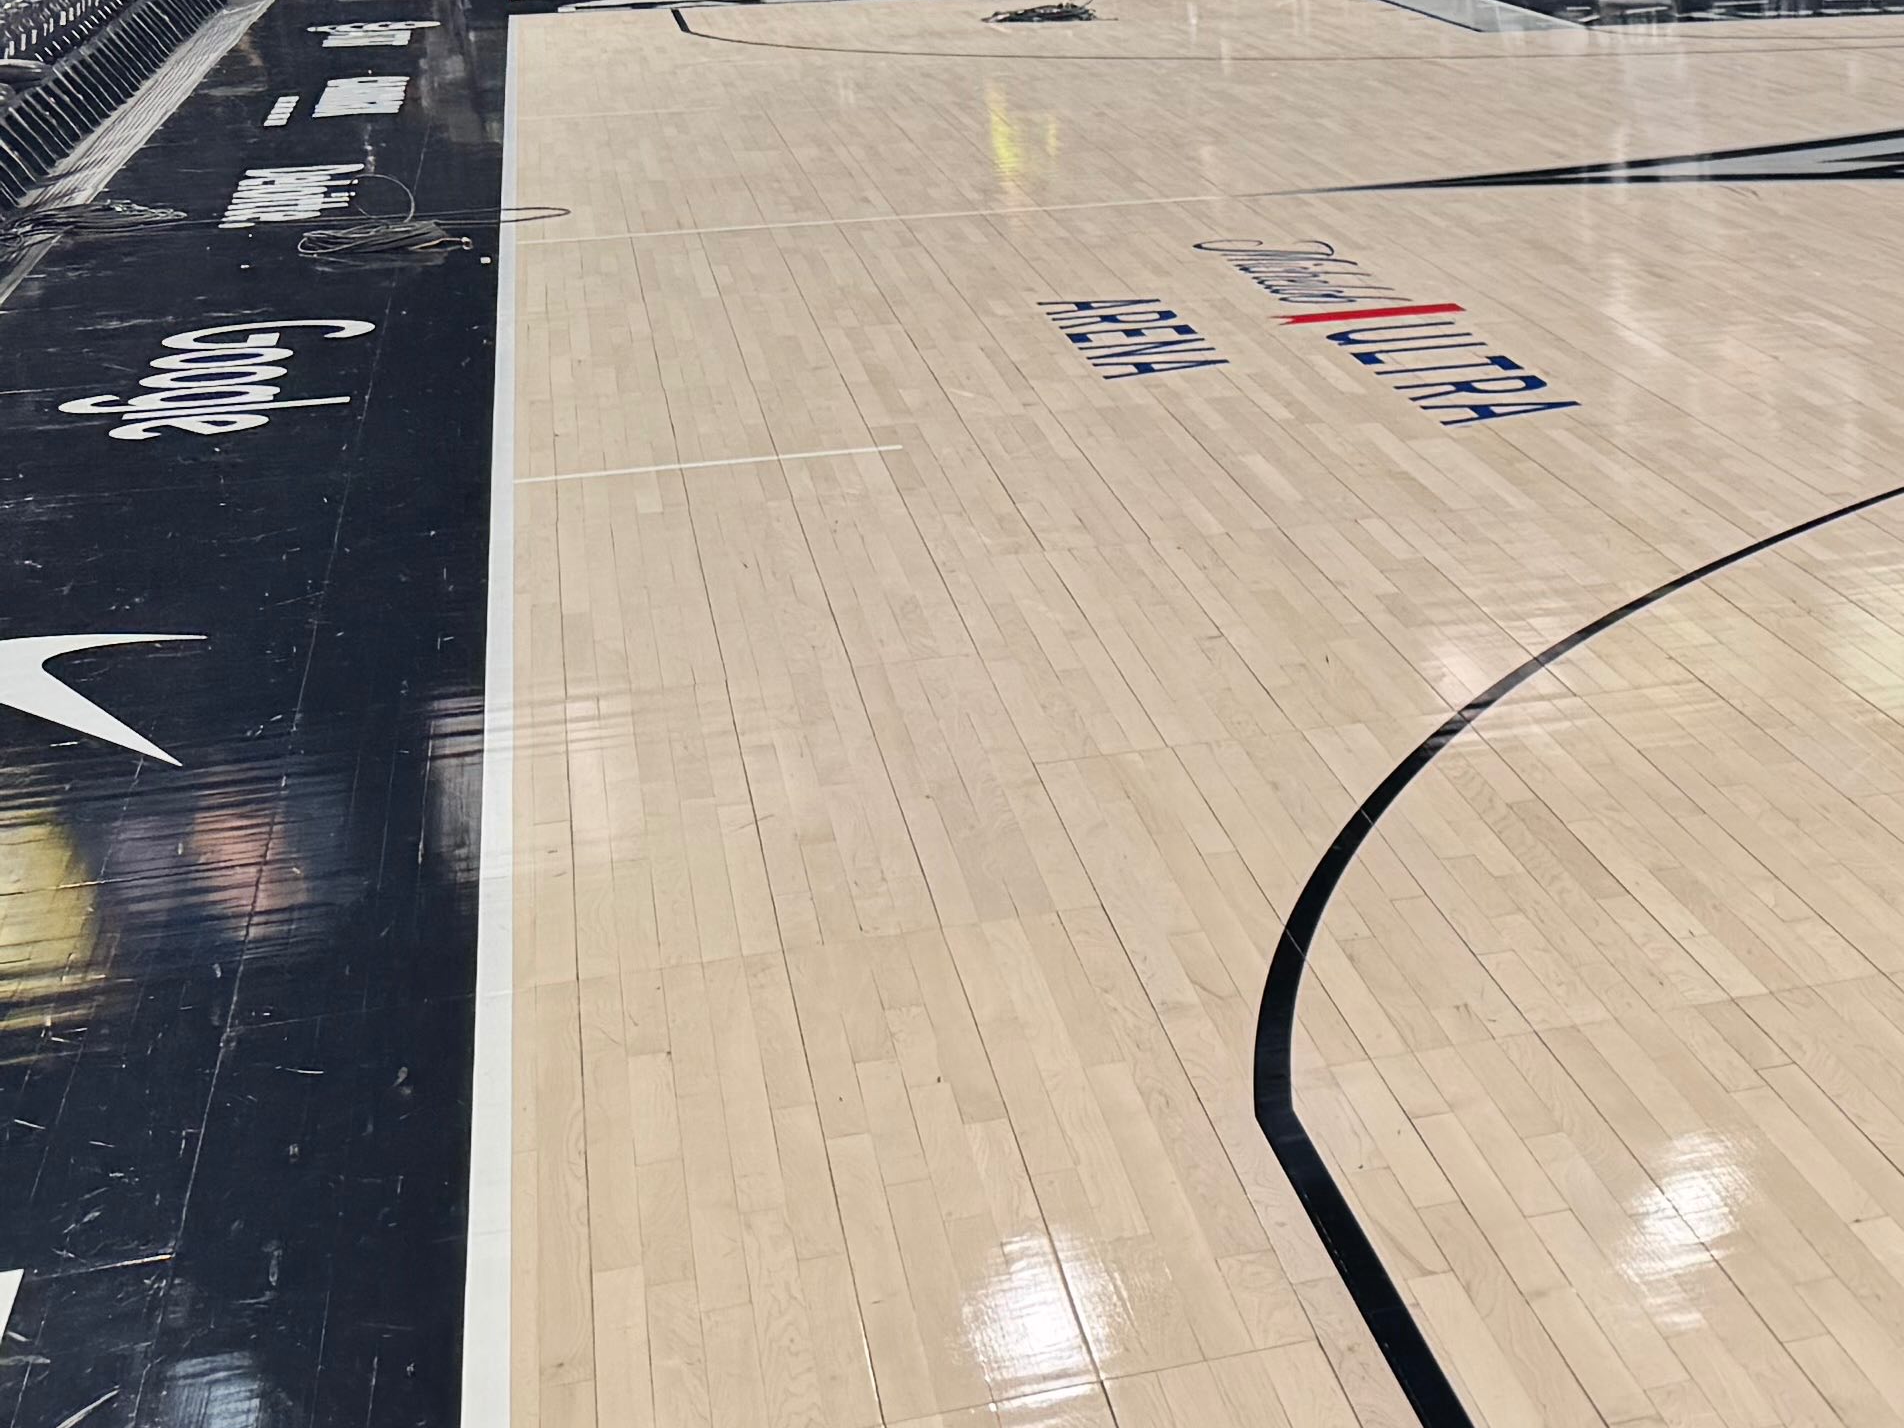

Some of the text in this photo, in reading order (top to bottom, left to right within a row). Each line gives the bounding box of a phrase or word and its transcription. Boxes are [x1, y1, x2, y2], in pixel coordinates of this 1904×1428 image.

[58, 319, 376, 440] Google
[1036, 298, 1231, 380] ARENA
[1192, 239, 1582, 428] Michelob ULTRA
